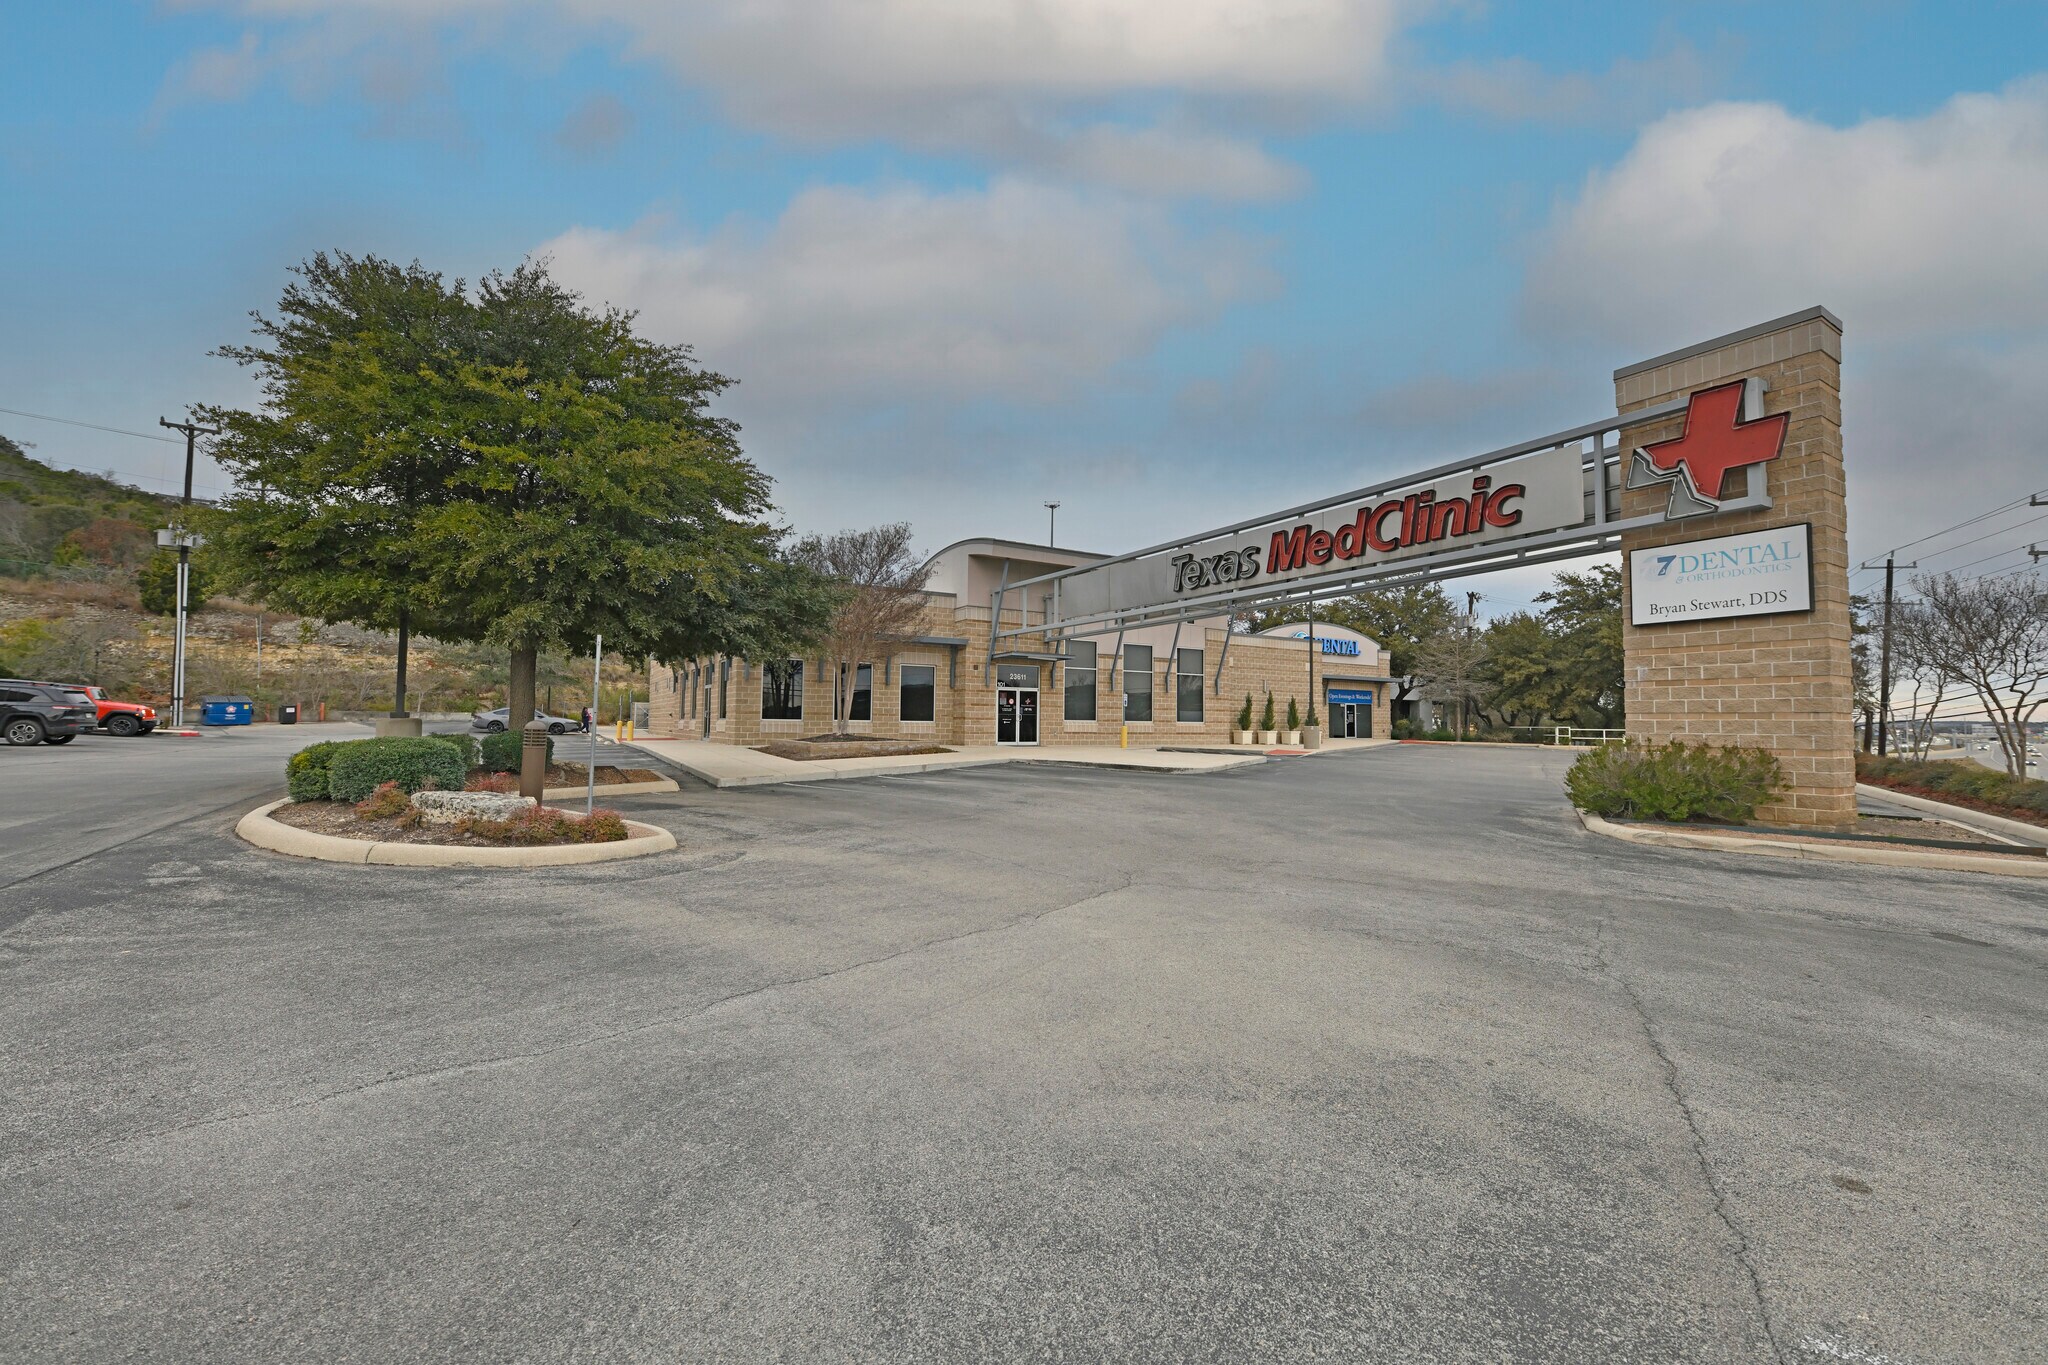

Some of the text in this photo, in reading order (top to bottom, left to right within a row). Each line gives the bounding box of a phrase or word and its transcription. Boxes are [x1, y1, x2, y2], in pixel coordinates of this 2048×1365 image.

[1171, 475, 1525, 592] Texas MedClinic
[1657, 541, 1800, 576] 7 DENTAL
[1675, 562, 1792, 584] & ORTHODONTICS
[1650, 589, 1788, 617] Bryan Stewart, DDS
[1317, 638, 1361, 655] ENTAL
